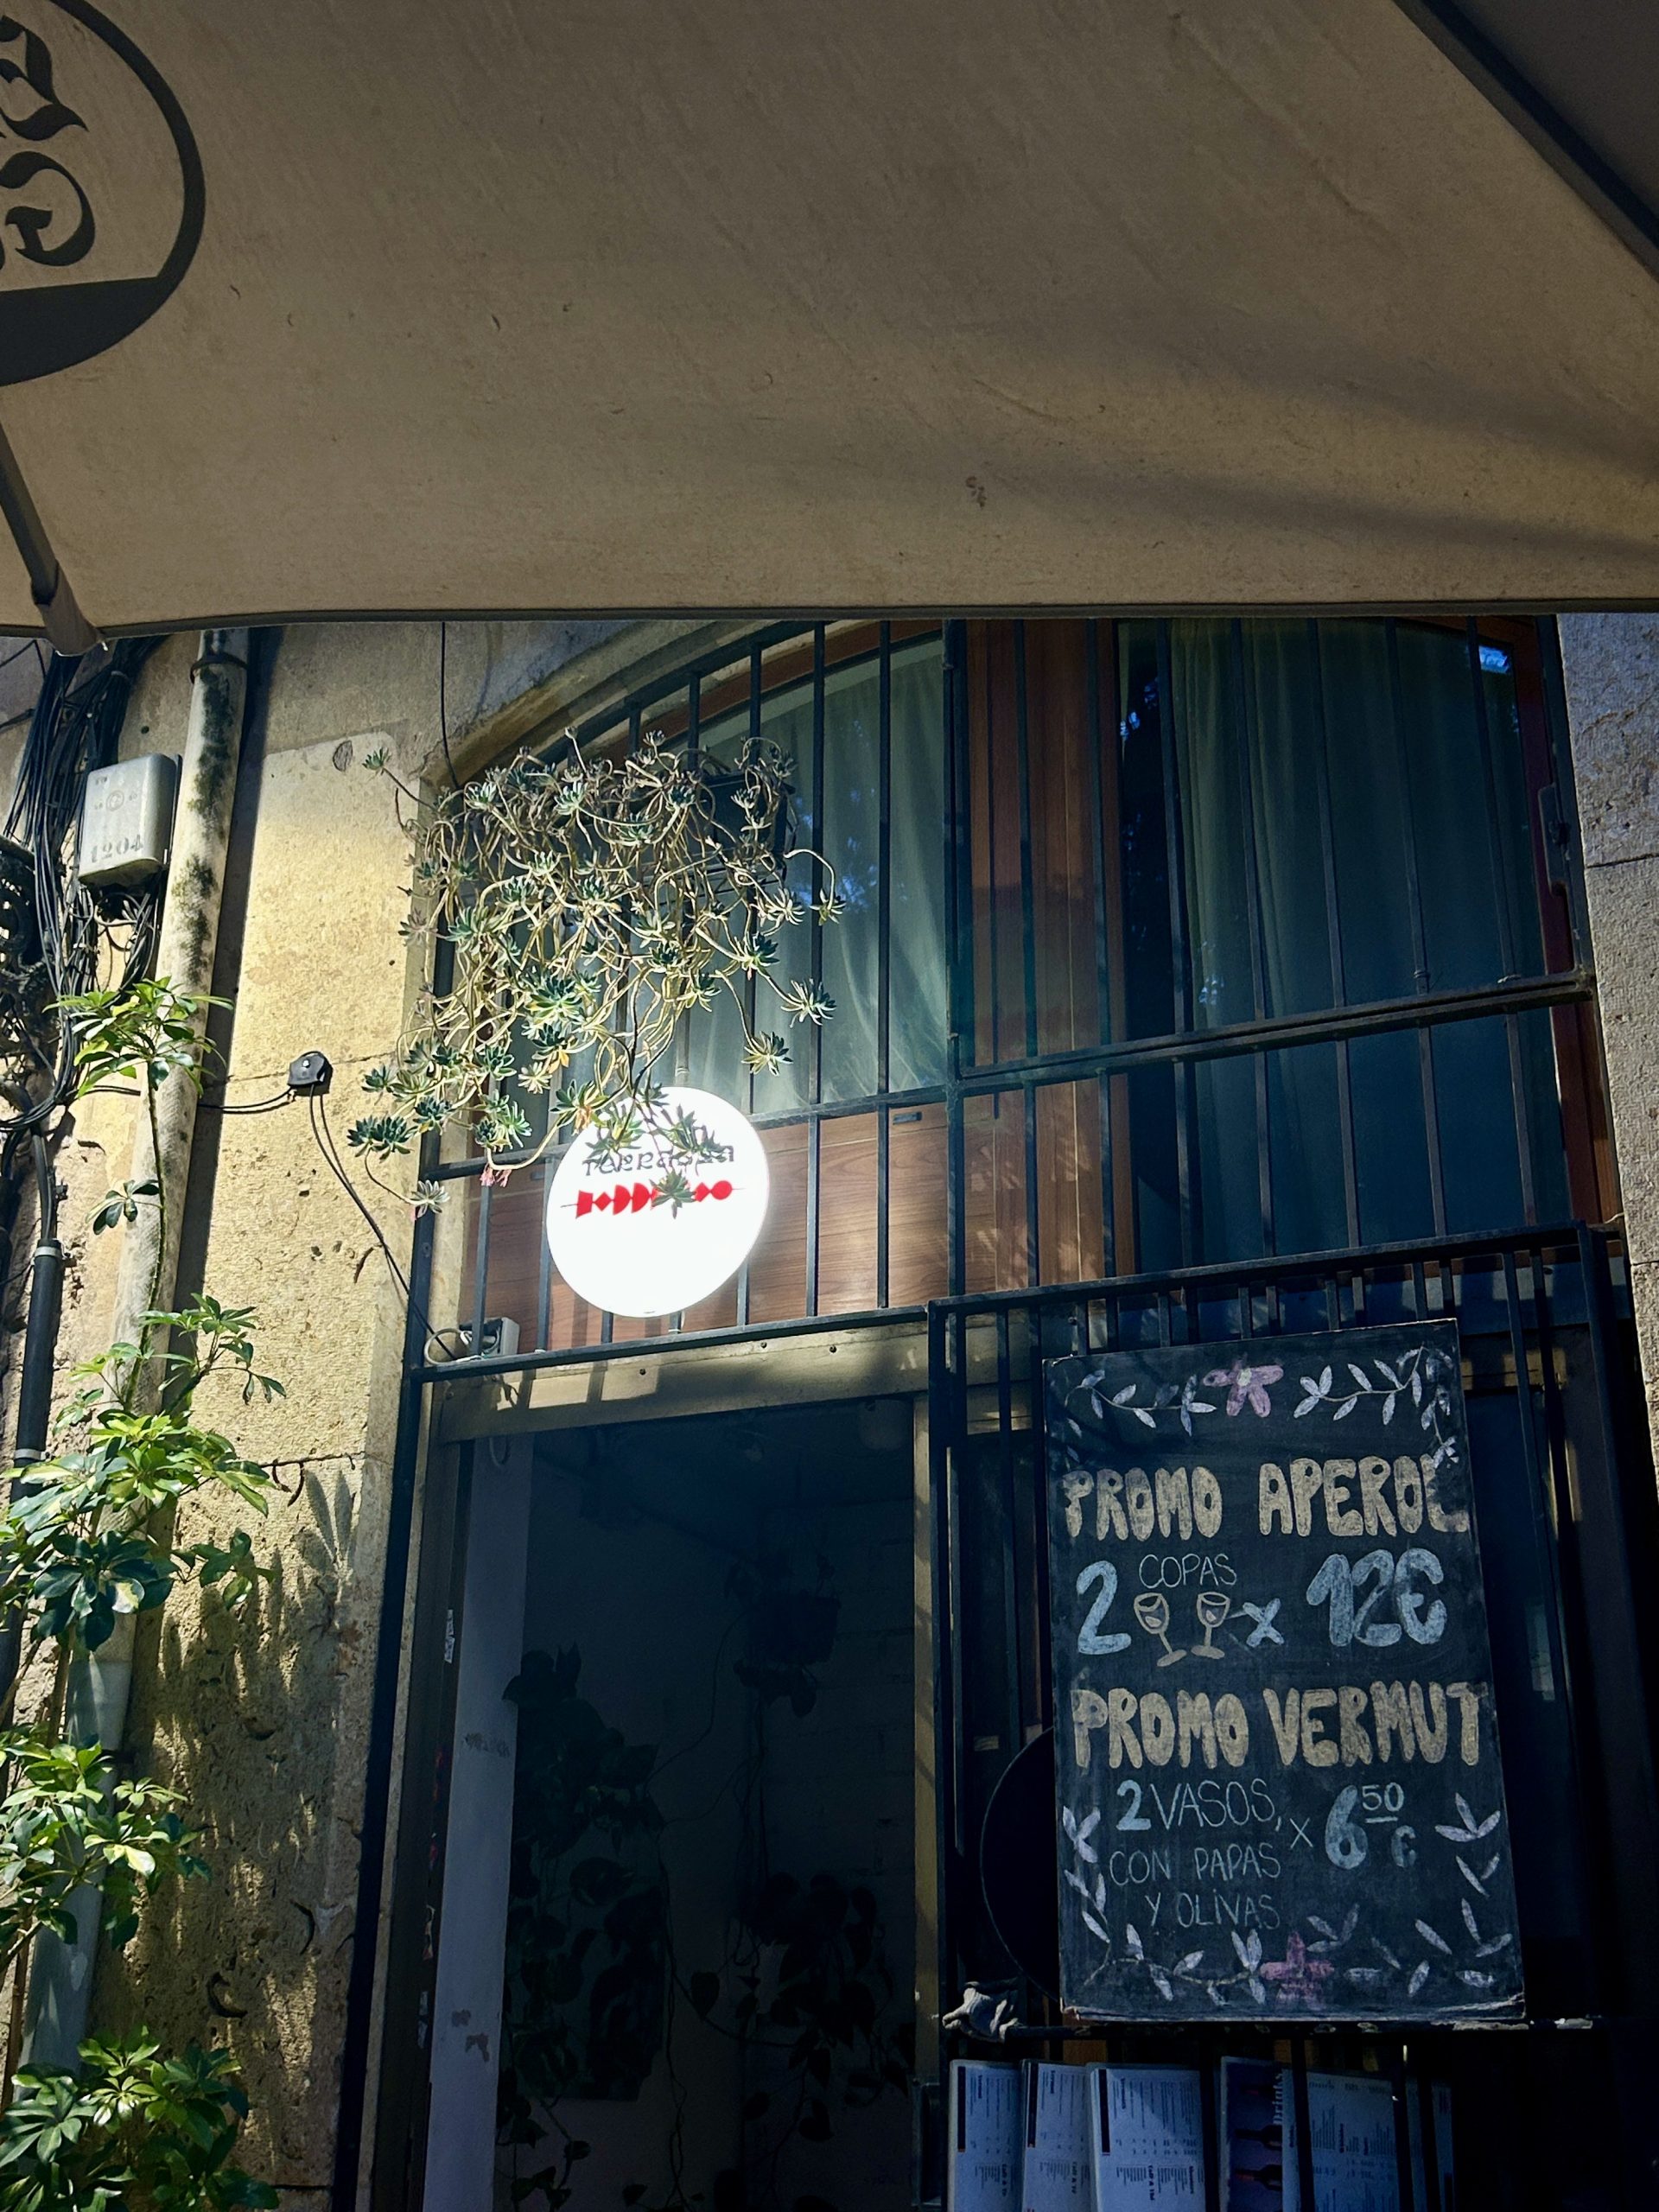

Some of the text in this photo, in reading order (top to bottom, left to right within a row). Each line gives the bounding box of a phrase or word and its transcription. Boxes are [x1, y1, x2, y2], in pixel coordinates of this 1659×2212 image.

[1064, 1455, 1470, 1541] PROMO APEROL
[1076, 1560, 1132, 1655] 2
[1139, 1554, 1237, 1588] COPAS
[1071, 1681, 1487, 1769] PROMO VERMUT
[1116, 1780, 1151, 1830] 2
[1109, 1842, 1281, 1886] CON PAPAS
[1145, 1895, 1161, 1927] Y
